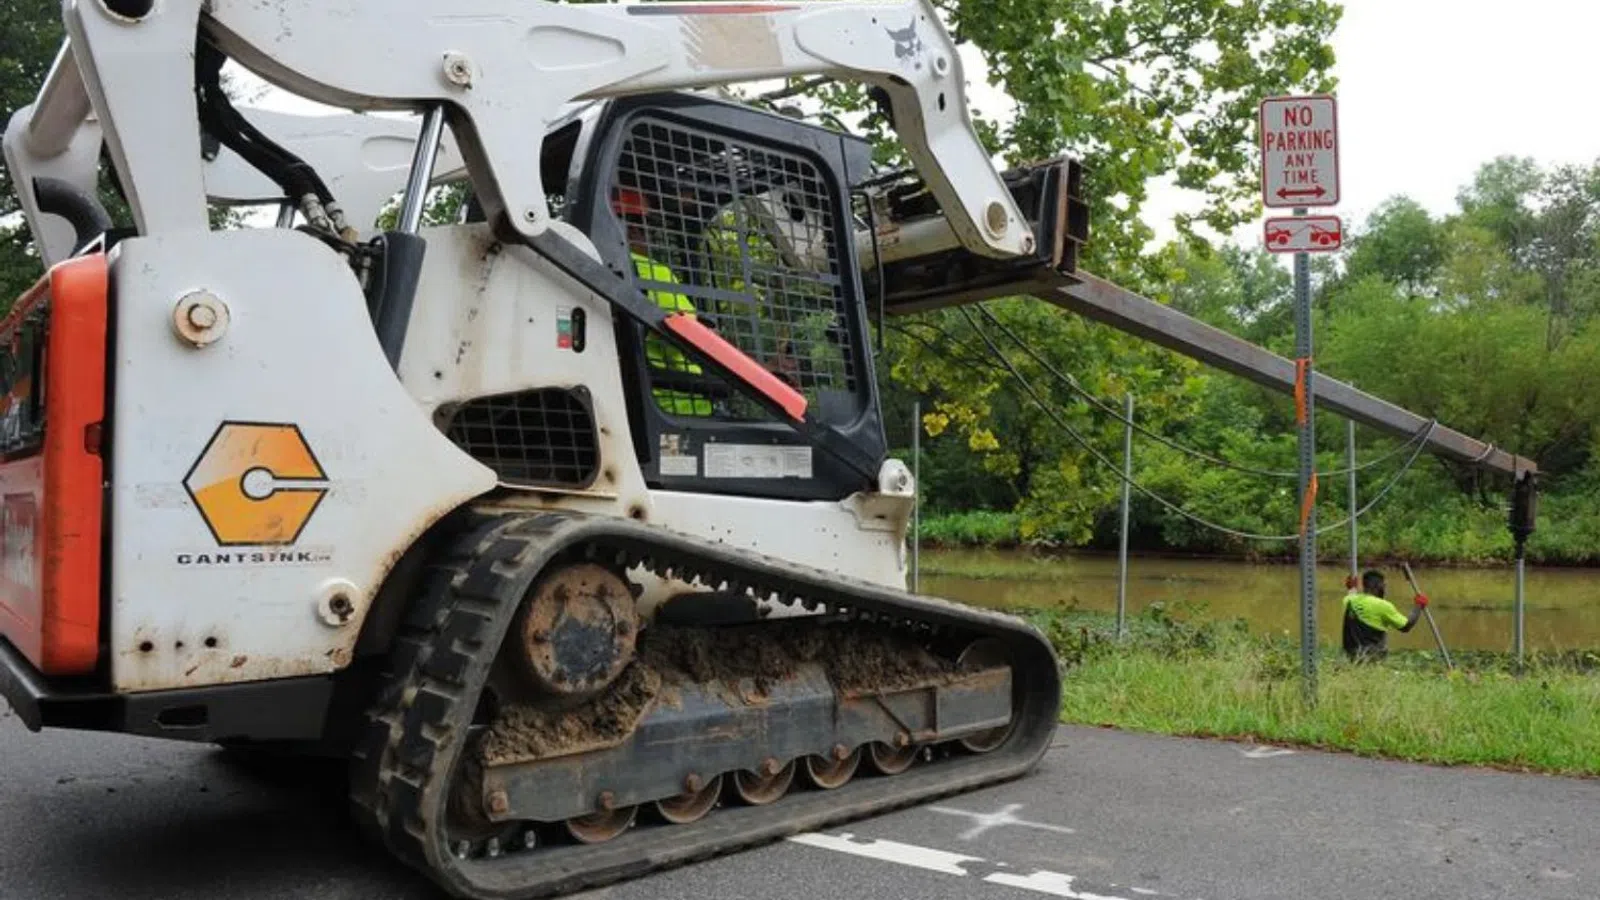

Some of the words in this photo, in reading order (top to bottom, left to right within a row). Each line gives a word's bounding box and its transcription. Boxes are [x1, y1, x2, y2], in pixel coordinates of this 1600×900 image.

[1284, 106, 1312, 127] NO
[1267, 130, 1333, 150] PARKING
[1285, 153, 1315, 167] ANY
[1283, 170, 1318, 184] TIME
